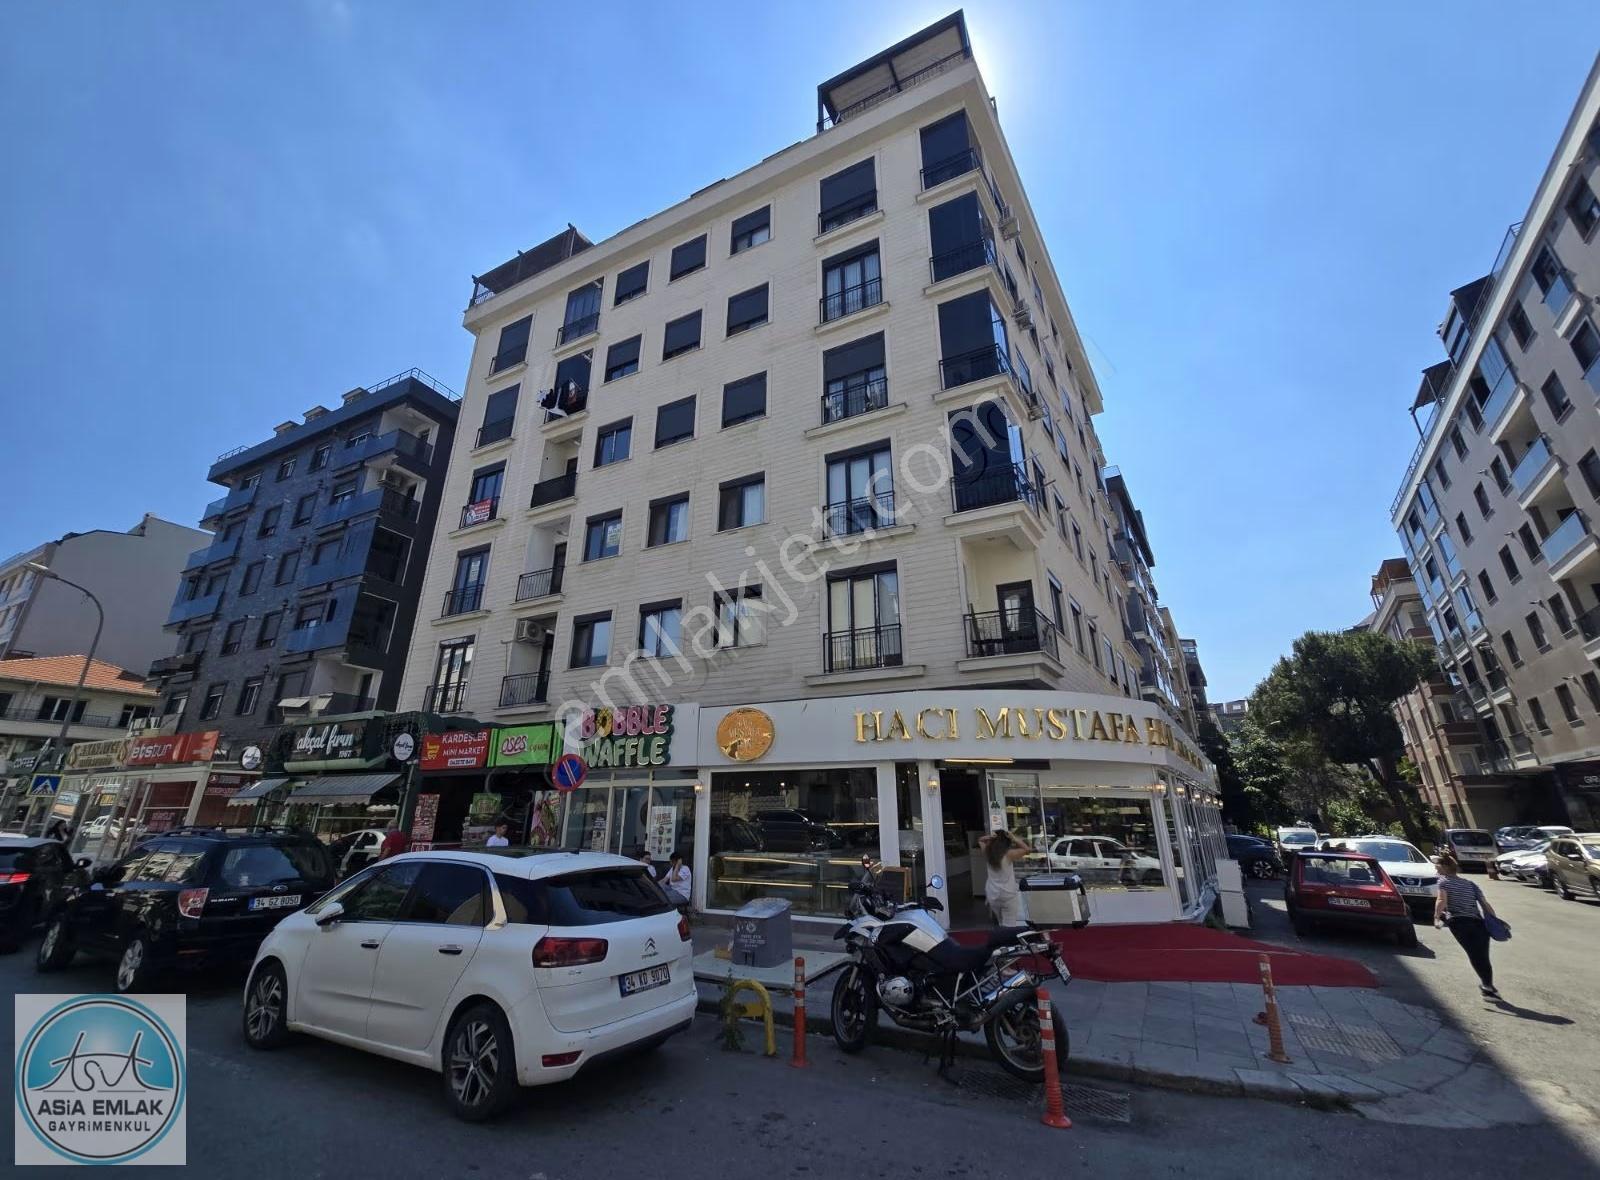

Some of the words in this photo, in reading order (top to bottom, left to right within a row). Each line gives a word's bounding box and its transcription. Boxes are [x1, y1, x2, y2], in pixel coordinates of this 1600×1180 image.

[581, 704, 669, 738] BOBBLE
[855, 707, 959, 742] HACI
[975, 706, 1142, 744] MUSTAFA
[131, 743, 172, 759] etstur
[459, 746, 485, 755] MARKET
[578, 737, 667, 768] WAFFLE
[255, 899, 265, 908] 34
[626, 975, 636, 990] 34
[651, 966, 668, 982] 9070
